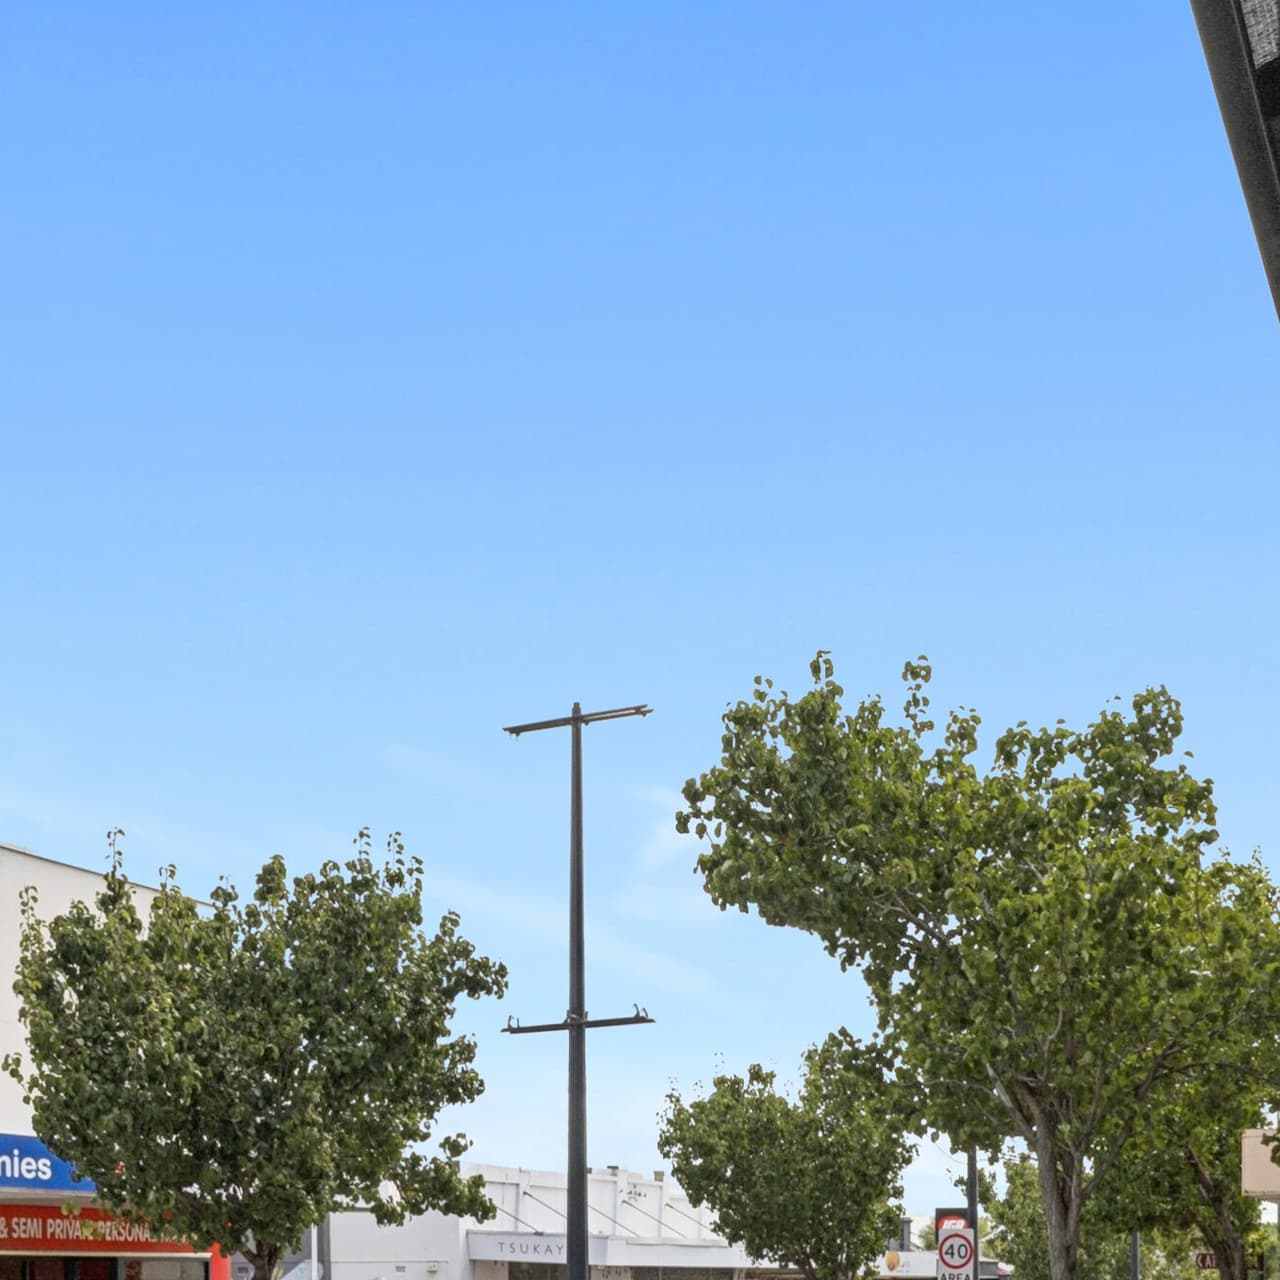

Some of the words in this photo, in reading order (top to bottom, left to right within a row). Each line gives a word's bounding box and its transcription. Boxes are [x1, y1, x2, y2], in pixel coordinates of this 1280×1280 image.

[11, 1216, 42, 1239] SEMI
[47, 1217, 94, 1240] PRIVA
[97, 1220, 157, 1242] PERSONA
[498, 1242, 564, 1256] TSUKAY
[944, 1243, 968, 1259] 40
